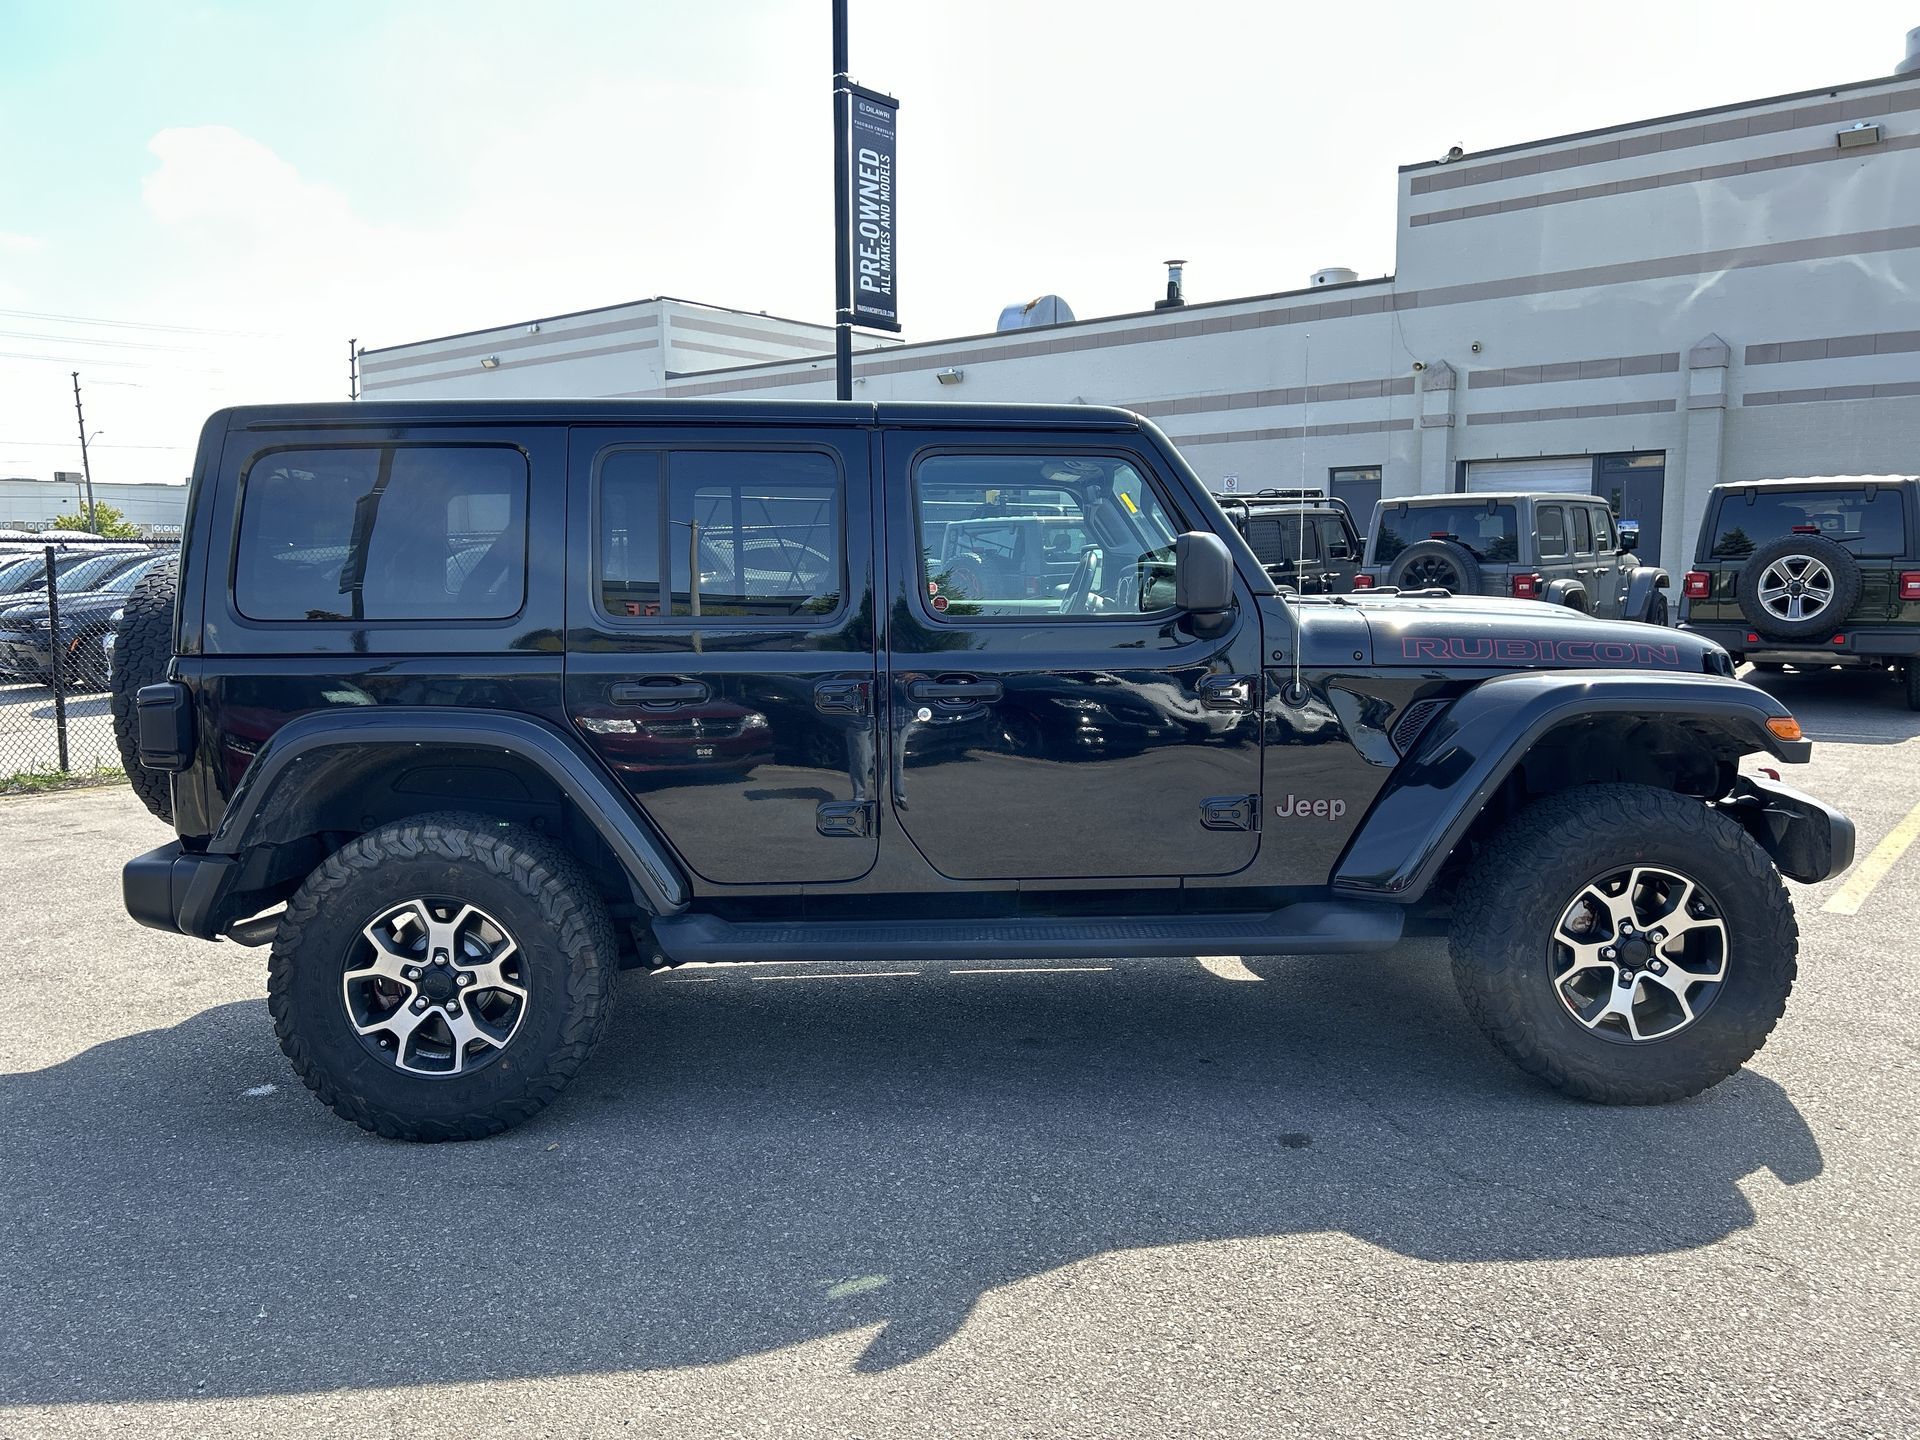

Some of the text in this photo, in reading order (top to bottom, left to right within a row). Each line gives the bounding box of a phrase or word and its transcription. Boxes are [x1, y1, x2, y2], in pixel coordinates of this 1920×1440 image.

[866, 105, 890, 119] DILAWRI
[859, 148, 881, 293] PRE-OWNED
[880, 154, 891, 295] ALL MAKES AND MODELS
[1402, 637, 1680, 664] RUBICON
[1276, 795, 1346, 820] Jeep
